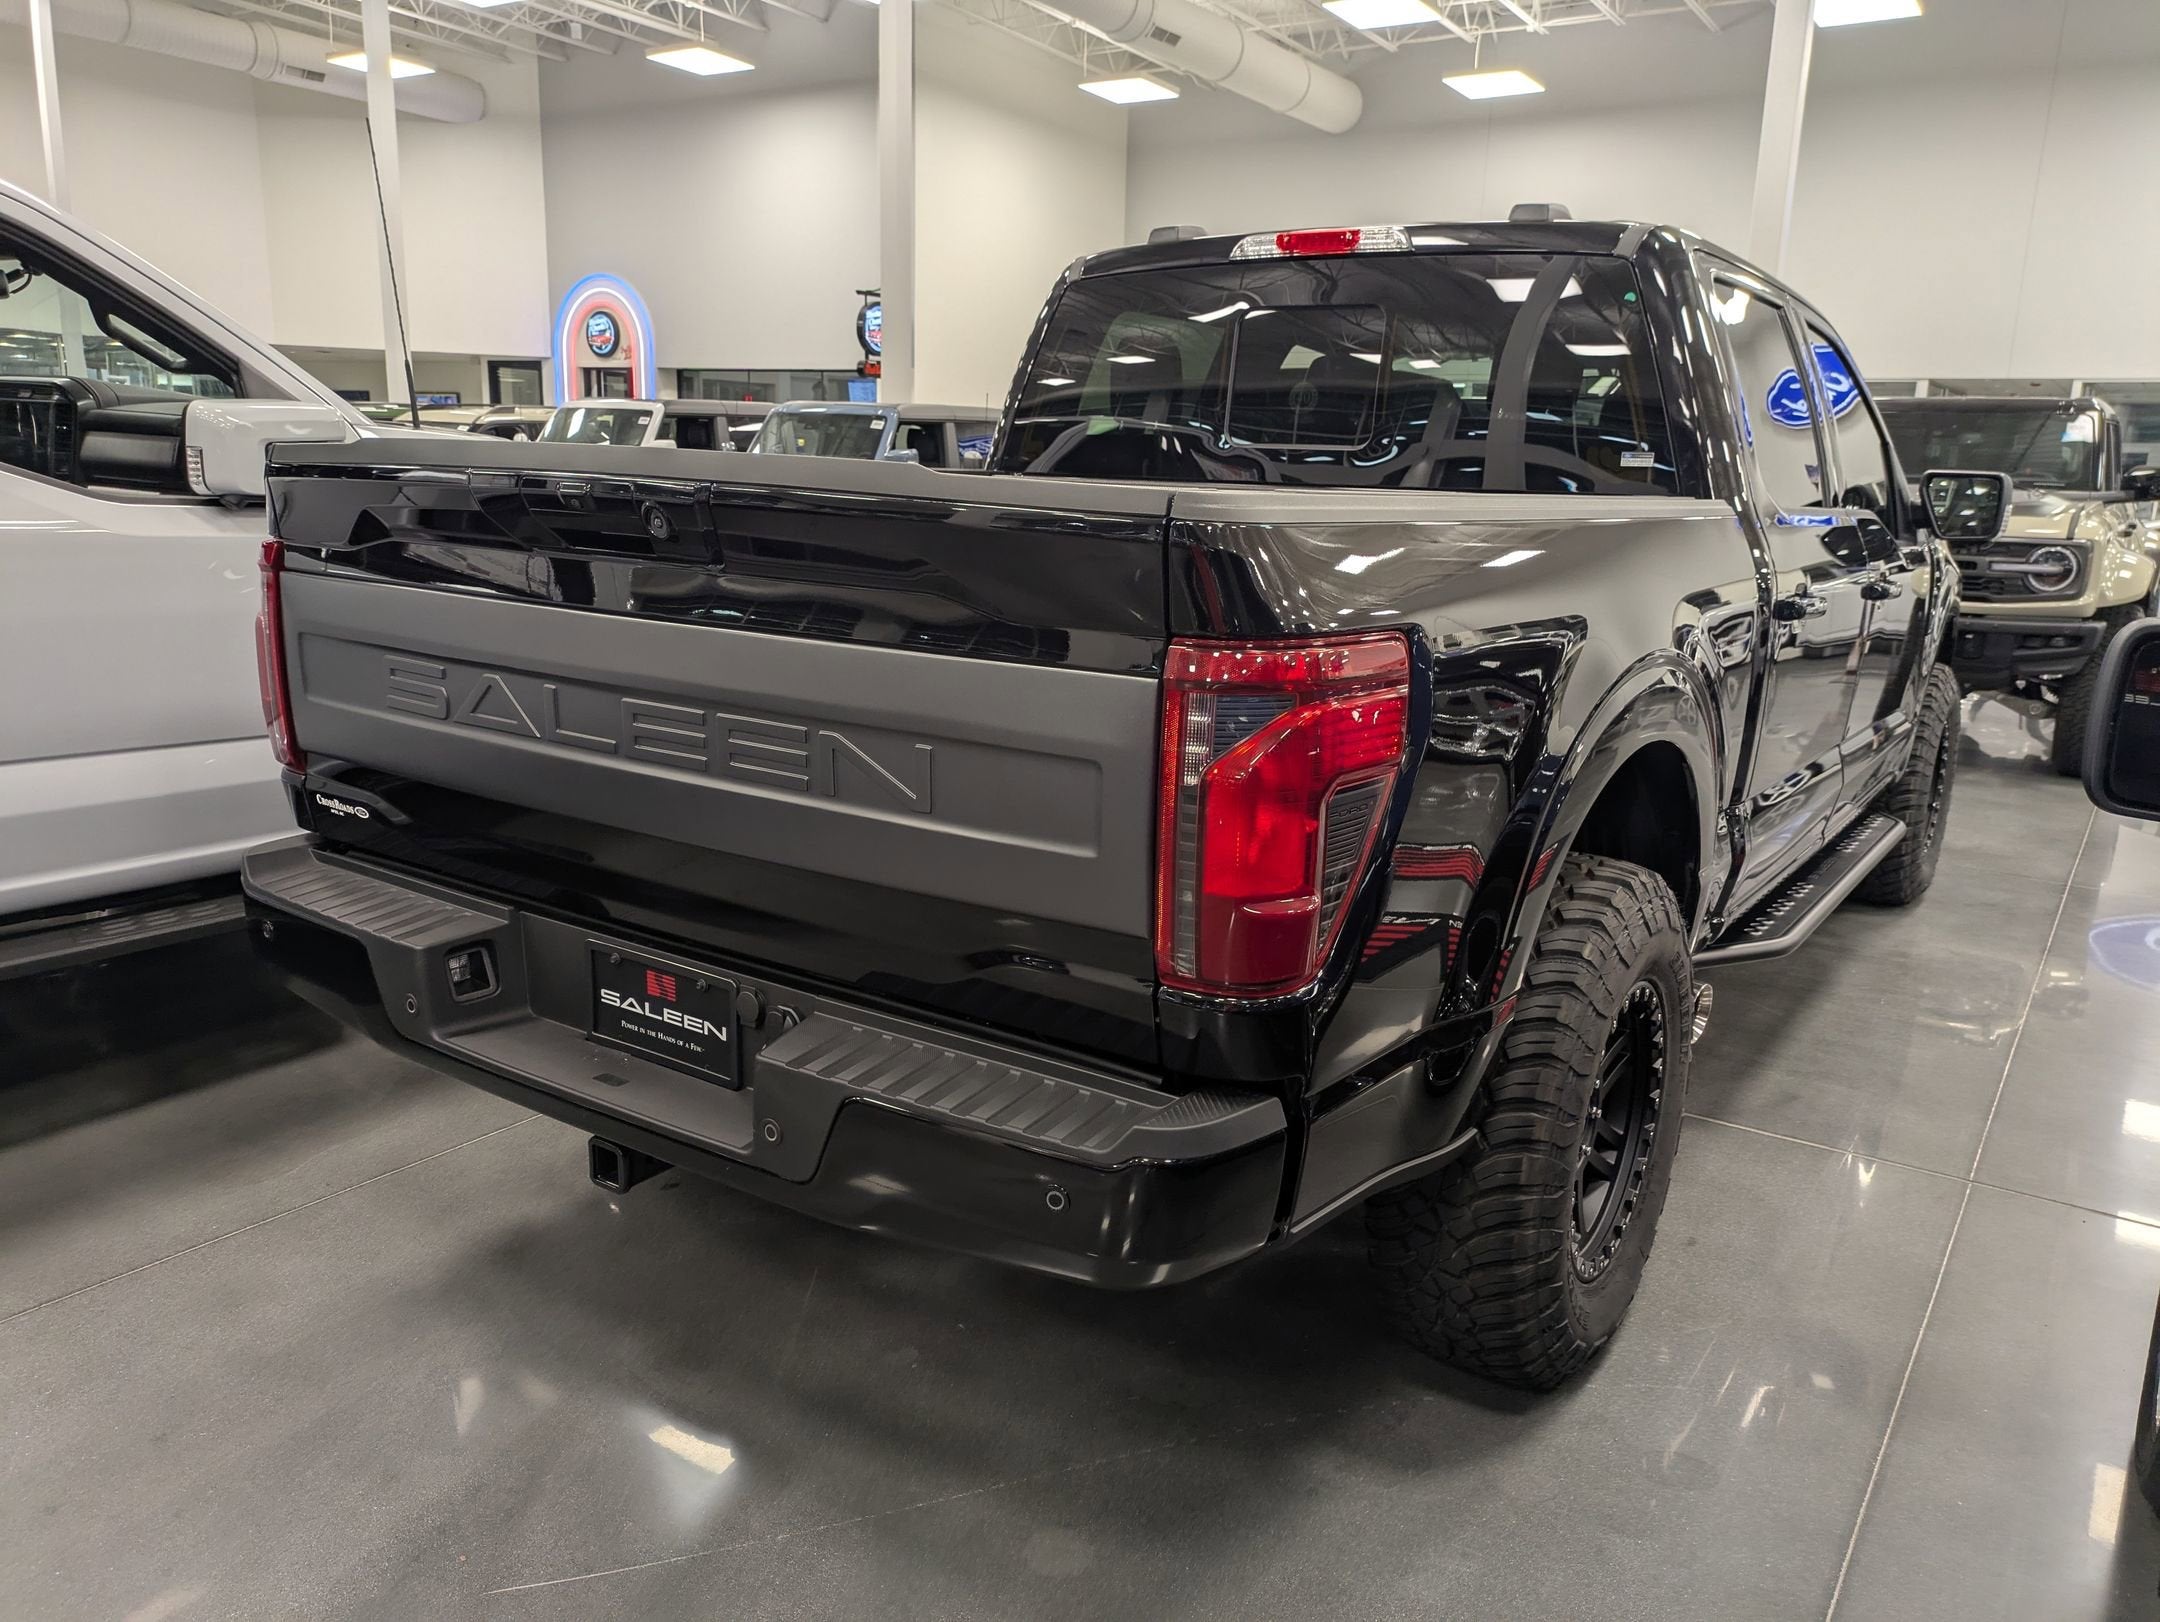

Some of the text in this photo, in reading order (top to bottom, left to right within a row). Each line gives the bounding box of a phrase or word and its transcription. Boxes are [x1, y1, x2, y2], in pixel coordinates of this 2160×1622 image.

[383, 653, 933, 815] SALEEN
[600, 988, 727, 1042] SALEEN
[621, 1020, 639, 1032] POWER
[639, 1027, 646, 1035] IN
[646, 1028, 657, 1038] THE
[657, 1031, 676, 1044] HANDS
